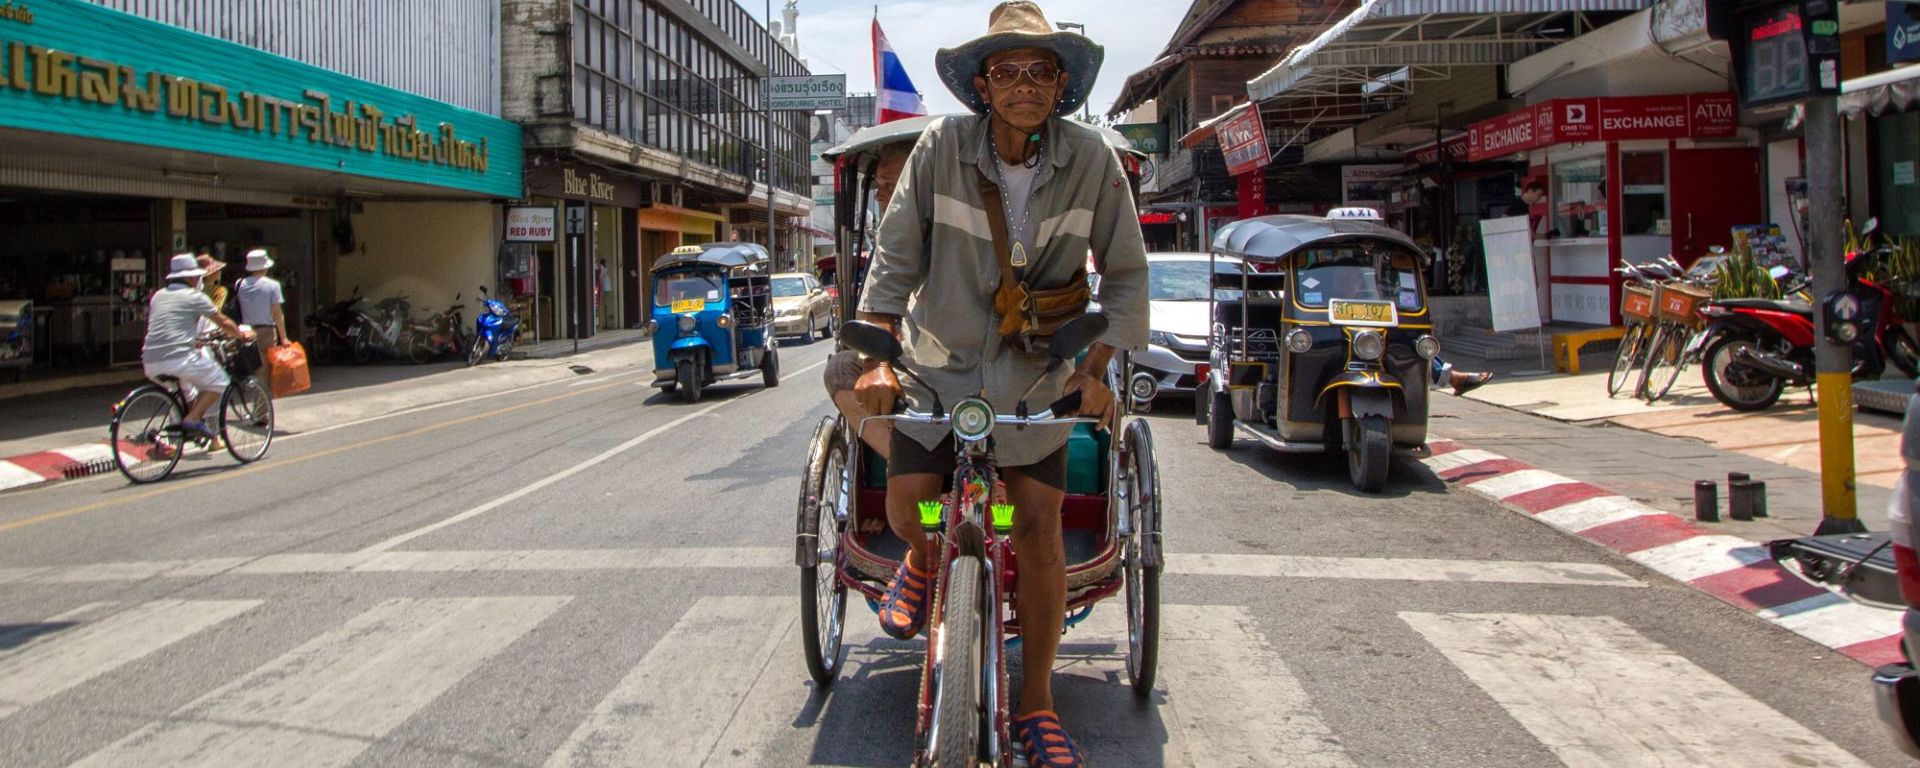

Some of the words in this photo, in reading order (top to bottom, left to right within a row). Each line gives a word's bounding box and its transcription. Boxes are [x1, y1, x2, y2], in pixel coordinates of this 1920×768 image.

[762, 78, 843, 95] โงแรมรุ่งเรือง
[818, 99, 843, 107] HOTEL
[1695, 103, 1732, 118] ATM
[1538, 111, 1554, 128] ATM
[1603, 115, 1685, 130] EXCHANGE
[1484, 123, 1532, 151] EXCHANGE
[563, 167, 588, 196] Blue
[590, 173, 615, 201] River
[530, 214, 552, 224] River
[1340, 209, 1372, 217] TAXI
[510, 227, 527, 237] RED
[529, 227, 552, 237] RUBY
